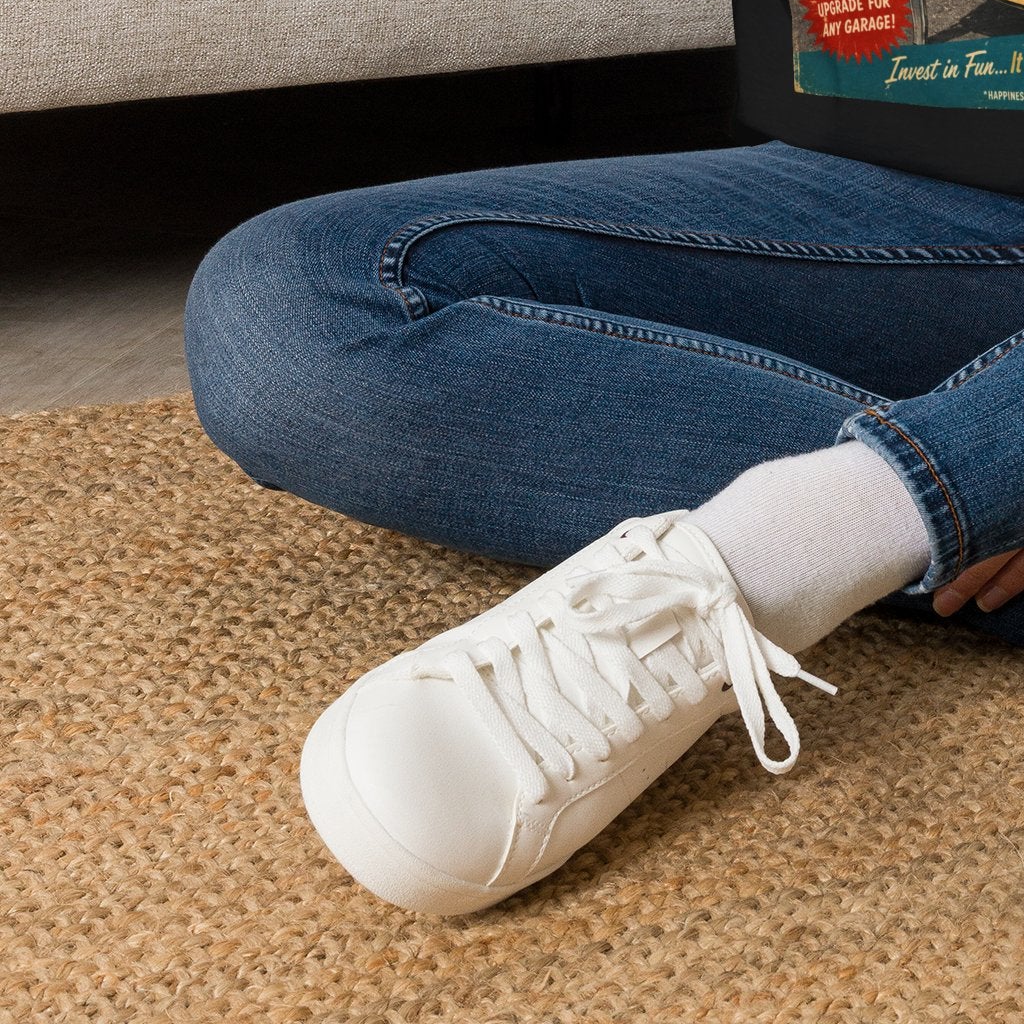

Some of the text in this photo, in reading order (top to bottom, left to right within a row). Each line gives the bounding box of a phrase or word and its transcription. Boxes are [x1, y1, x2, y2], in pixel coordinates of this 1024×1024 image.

[822, 13, 896, 37] ANY GARAGE!
[884, 55, 942, 84] Invest
[942, 59, 960, 79] in
[1010, 50, 1023, 74] It
